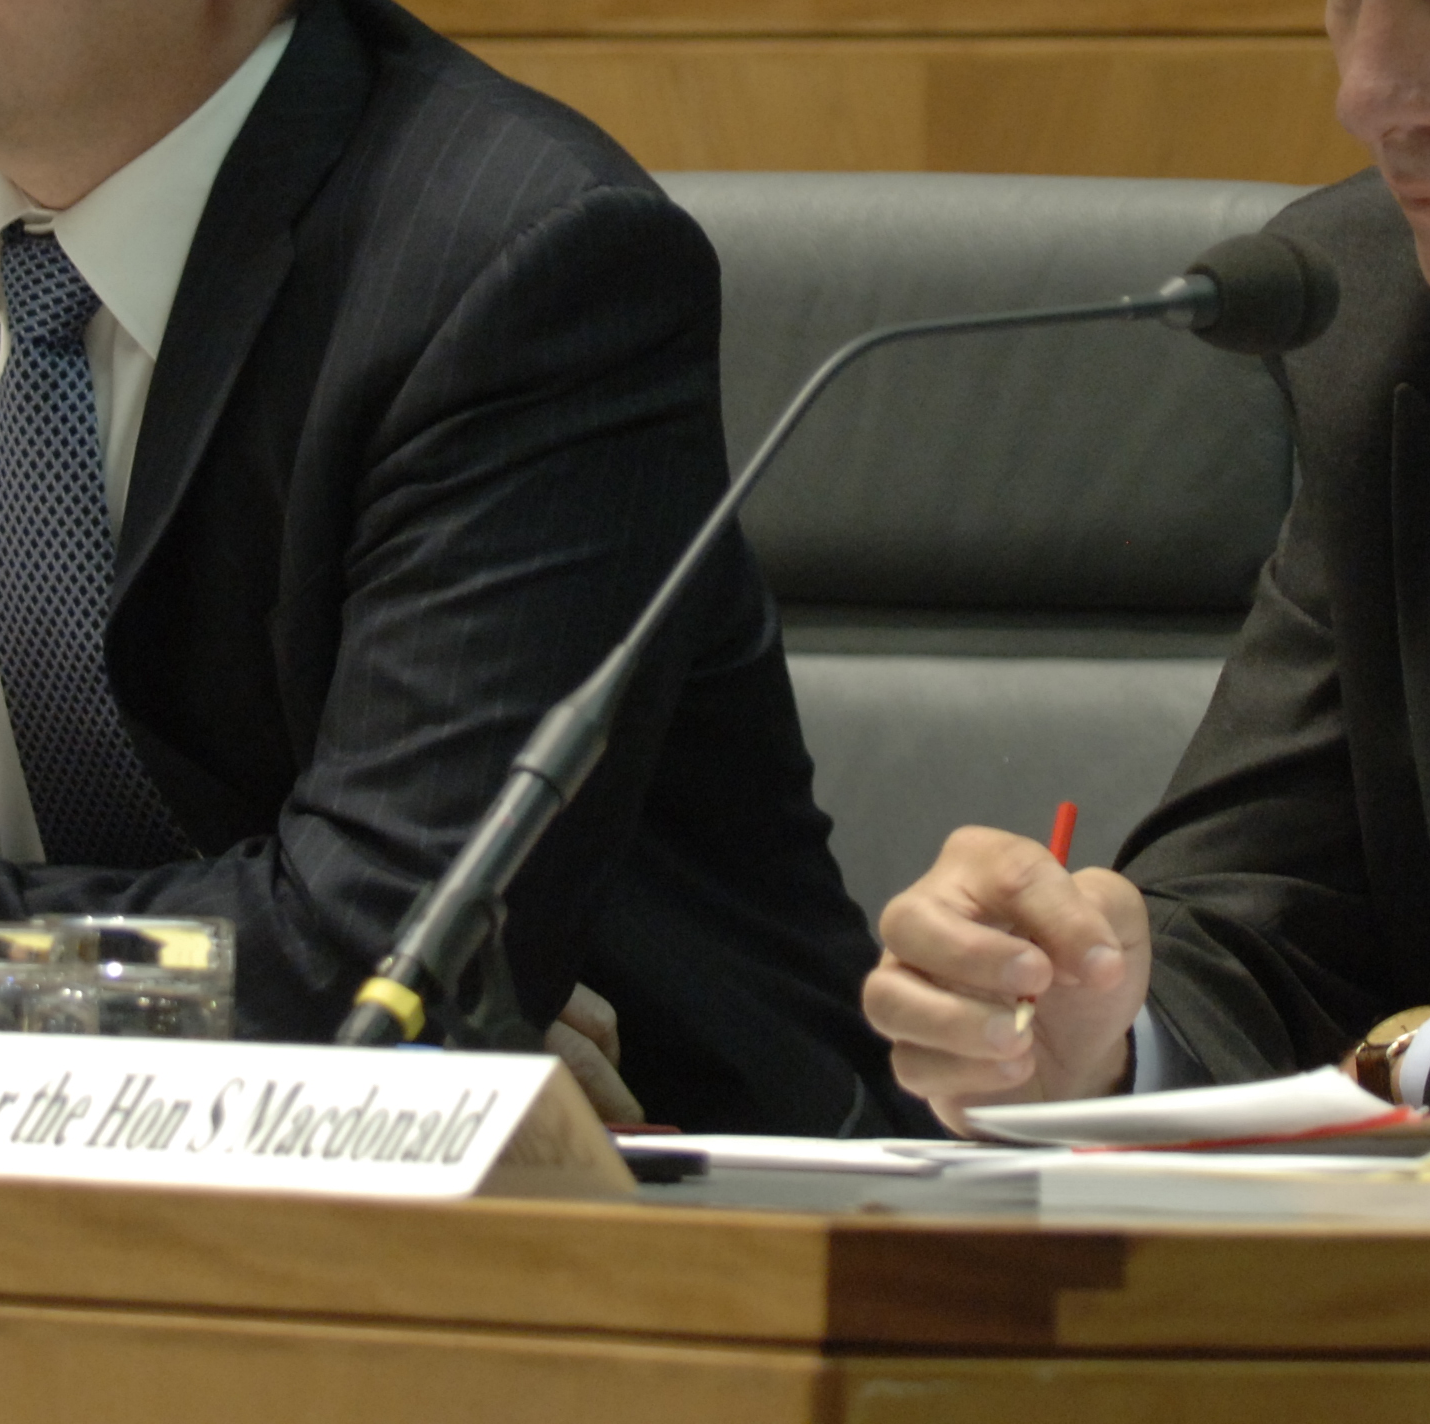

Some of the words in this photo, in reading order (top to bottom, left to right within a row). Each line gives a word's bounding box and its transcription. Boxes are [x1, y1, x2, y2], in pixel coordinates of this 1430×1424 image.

[9, 1070, 93, 1147] the
[83, 1072, 192, 1151] Hon
[185, 1077, 245, 1154] S
[224, 1079, 498, 1165] Macdonald
